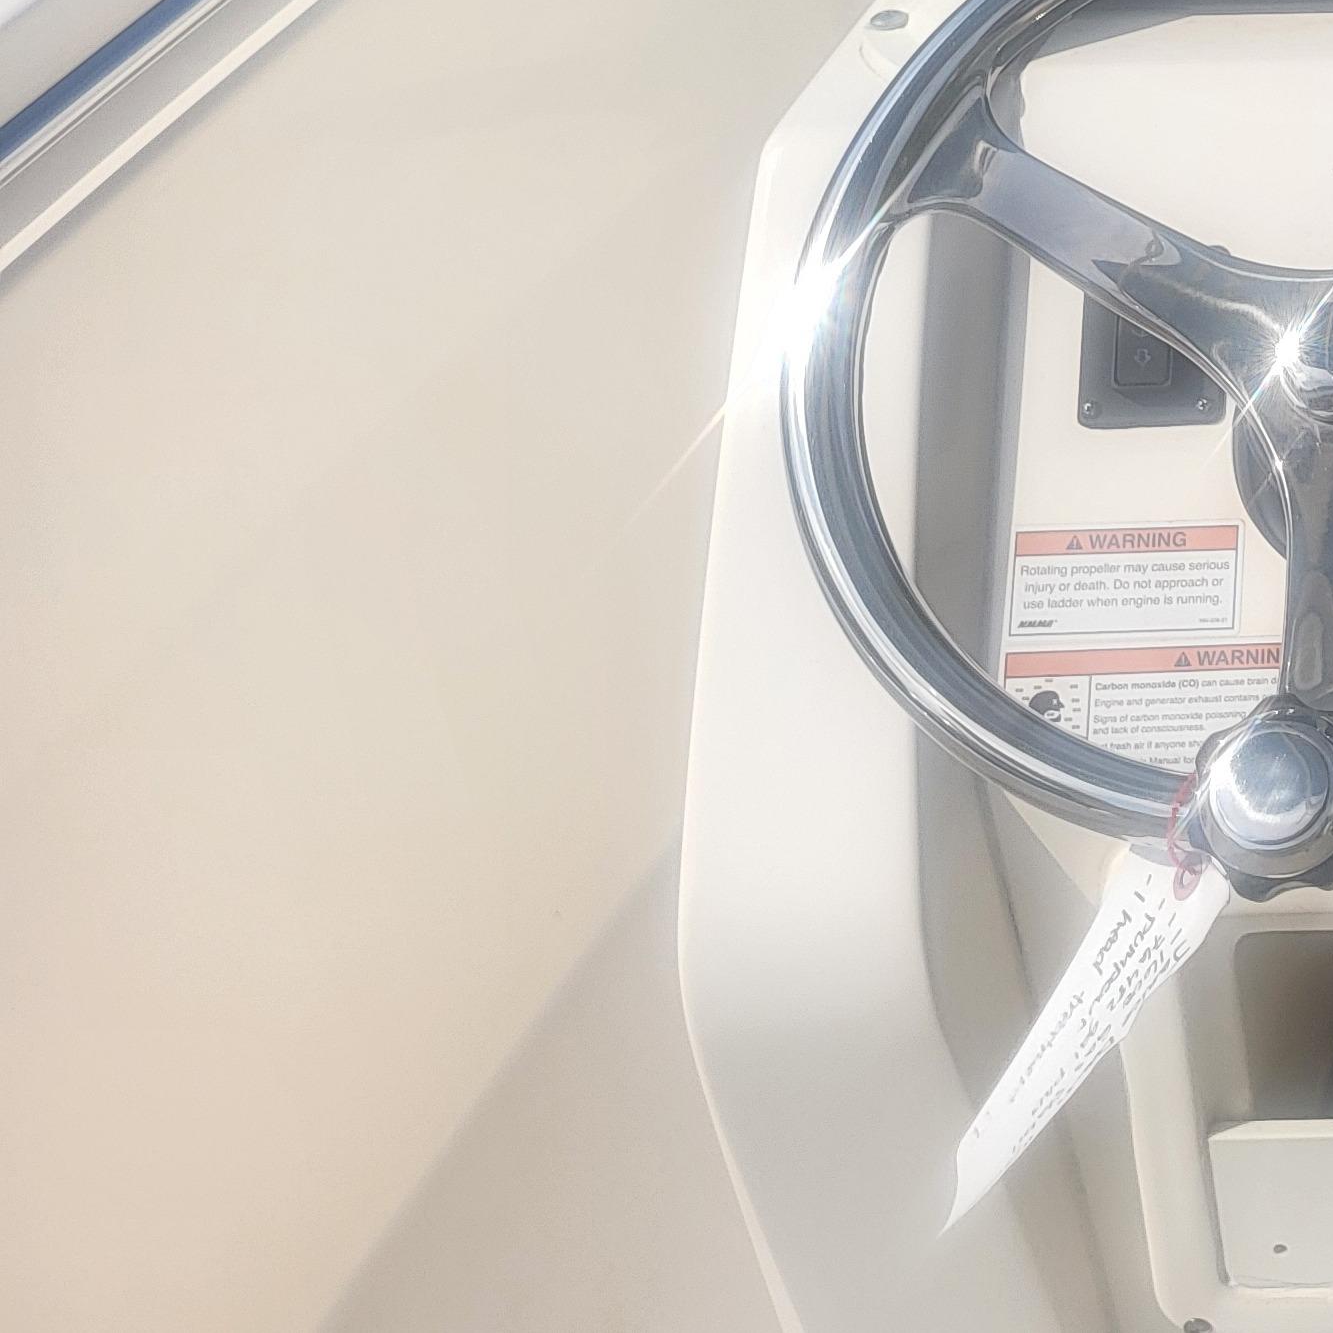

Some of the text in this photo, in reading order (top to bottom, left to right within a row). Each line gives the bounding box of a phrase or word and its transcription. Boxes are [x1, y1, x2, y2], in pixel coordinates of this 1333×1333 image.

[1088, 532, 1187, 550] WARNING
[1020, 559, 1230, 579] Rotating propeller may cause serious
[1025, 575, 1224, 594] injury or death. Do not approach or
[1023, 592, 1223, 610] use ladder when engine is running.
[1196, 647, 1280, 666] WARNIN
[1095, 677, 1269, 691] Carbon monoxide (CO) can cause brain
[1094, 692, 1260, 709] Engine and generator exhaust contains
[1093, 713, 1118, 725] Signs
[1120, 713, 1129, 722] of
[1130, 712, 1160, 722] carbon
[1161, 710, 1204, 721] monoxide
[1093, 722, 1205, 735] and lack of consciousness.
[1133, 740, 1146, 750] air
[1147, 739, 1152, 748] if
[1154, 739, 1191, 752] anyone
